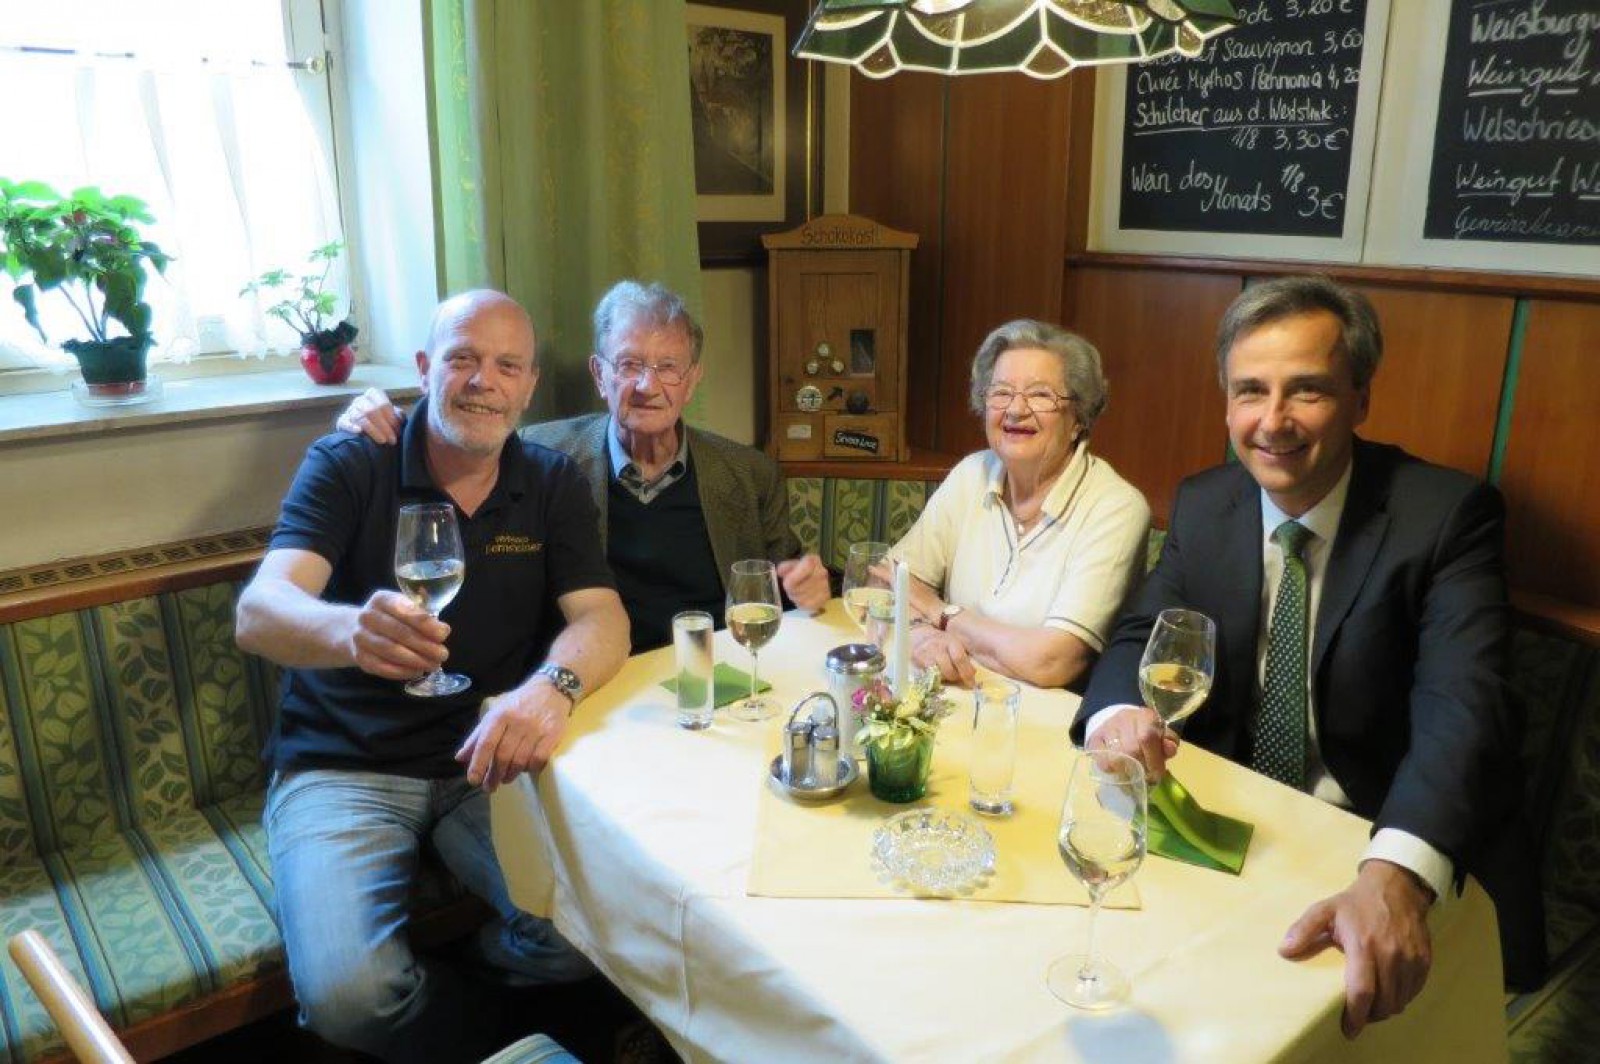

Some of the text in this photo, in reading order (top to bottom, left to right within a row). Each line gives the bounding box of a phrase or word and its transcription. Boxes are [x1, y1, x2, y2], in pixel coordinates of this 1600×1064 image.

[1222, 35, 1314, 75] Sauvignon
[1187, 66, 1243, 98] Mythos
[1468, 41, 1590, 107] Weingut
[1213, 106, 1243, 123] aus
[1130, 162, 1172, 193] Wein
[1179, 159, 1213, 190] des
[1455, 156, 1565, 206] Weingut
[1201, 177, 1272, 212] Monats
